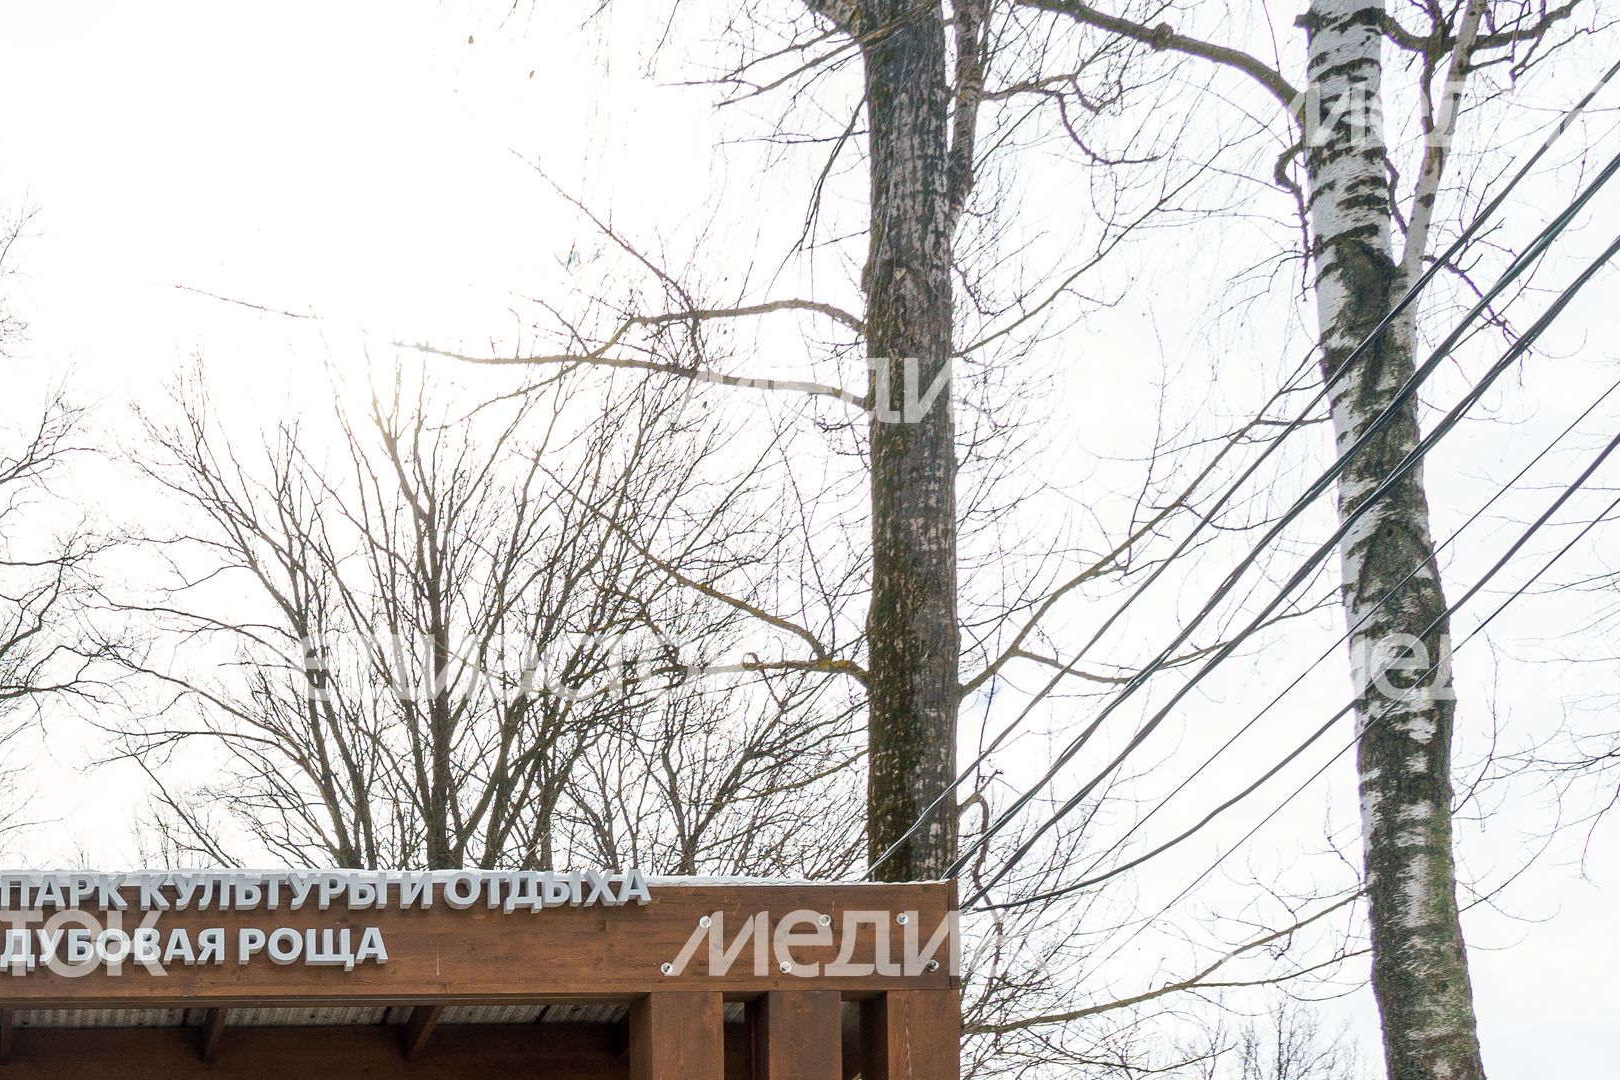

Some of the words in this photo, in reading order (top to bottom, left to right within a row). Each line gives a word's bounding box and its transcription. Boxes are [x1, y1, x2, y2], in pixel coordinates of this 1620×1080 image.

[0, 873, 129, 912] ПАРК
[140, 872, 387, 912] КУЛЬТУРЫ
[401, 872, 434, 910] И
[442, 868, 652, 914] ОТДЫХА
[0, 926, 227, 972] ДУБОВАЯ
[239, 926, 389, 972] РОЩА
